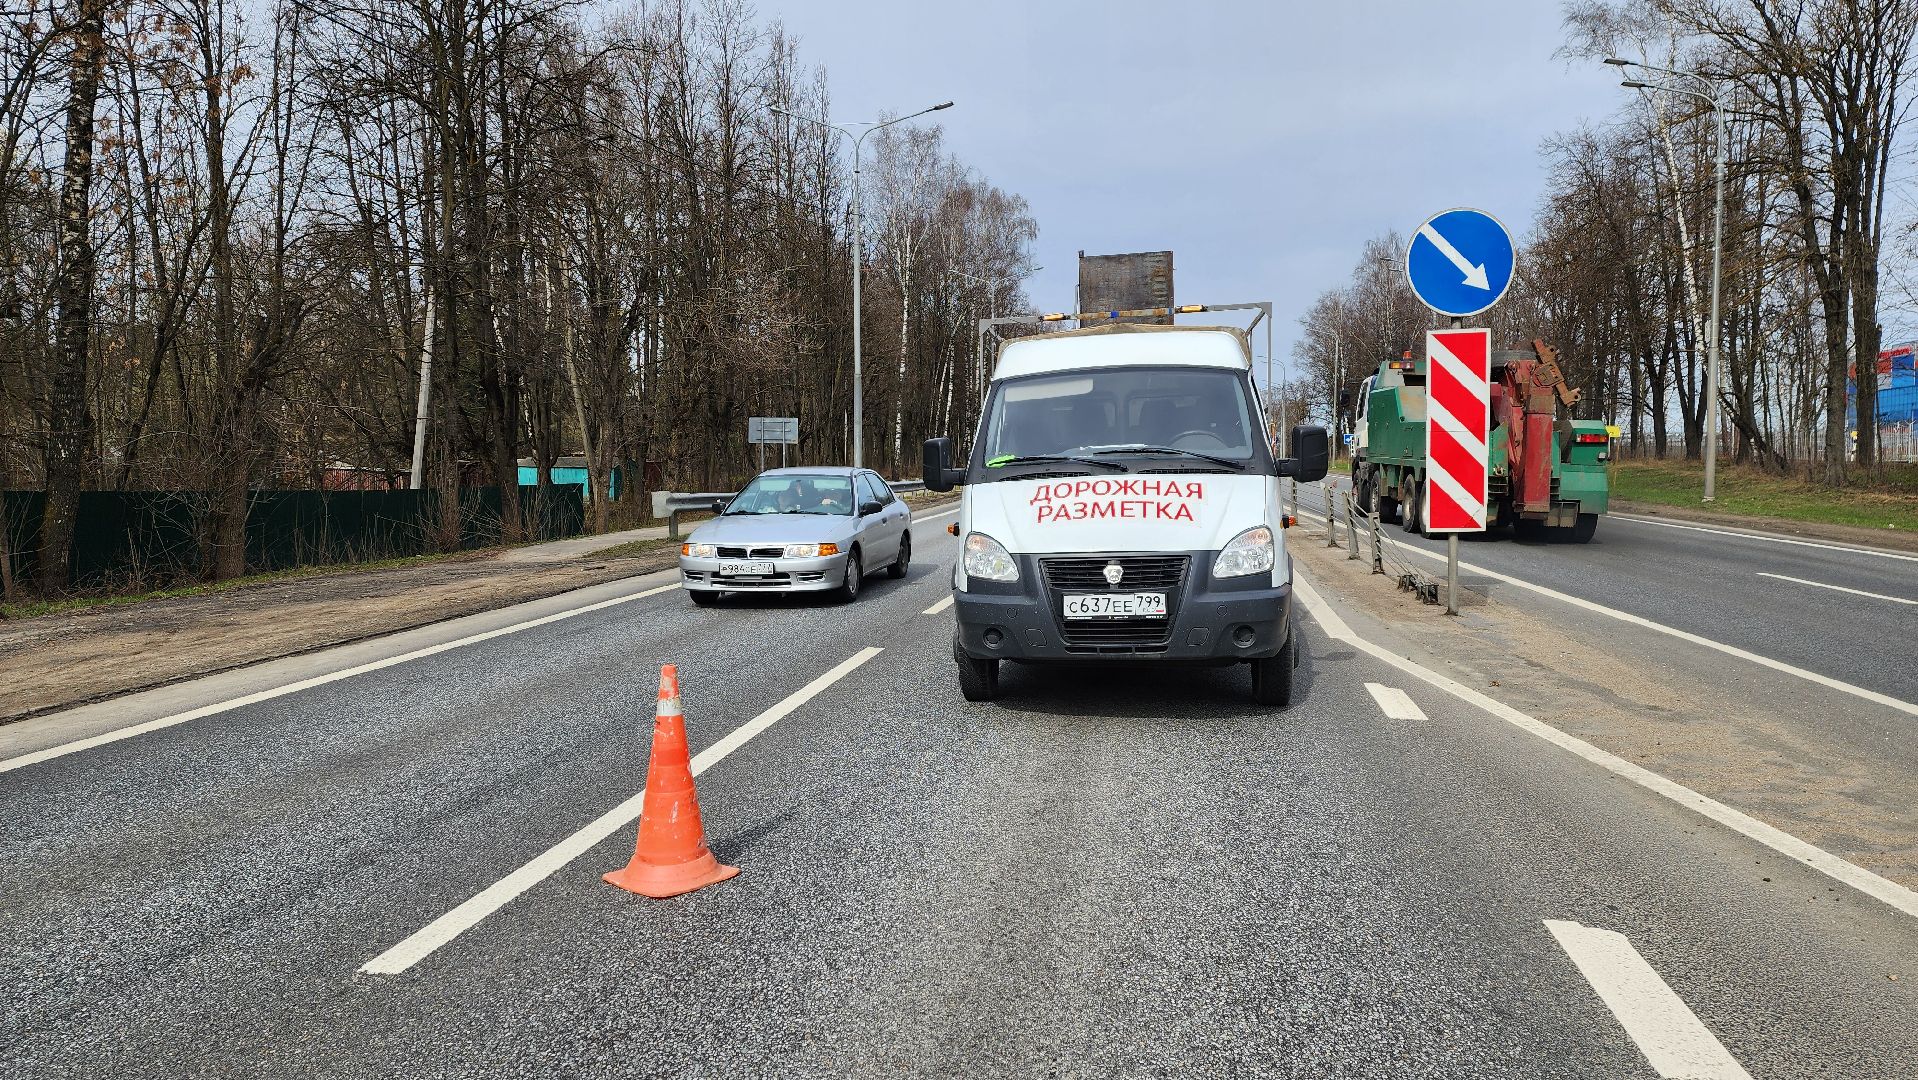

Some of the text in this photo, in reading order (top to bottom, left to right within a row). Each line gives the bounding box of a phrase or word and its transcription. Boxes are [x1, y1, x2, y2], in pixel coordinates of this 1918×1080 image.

[1030, 480, 1203, 505] ДОРОЖНАЯ
[1037, 501, 1194, 523] РАЗМЕТКА
[1069, 597, 1133, 613] С637ЕЕ
[1136, 595, 1161, 607] 799
